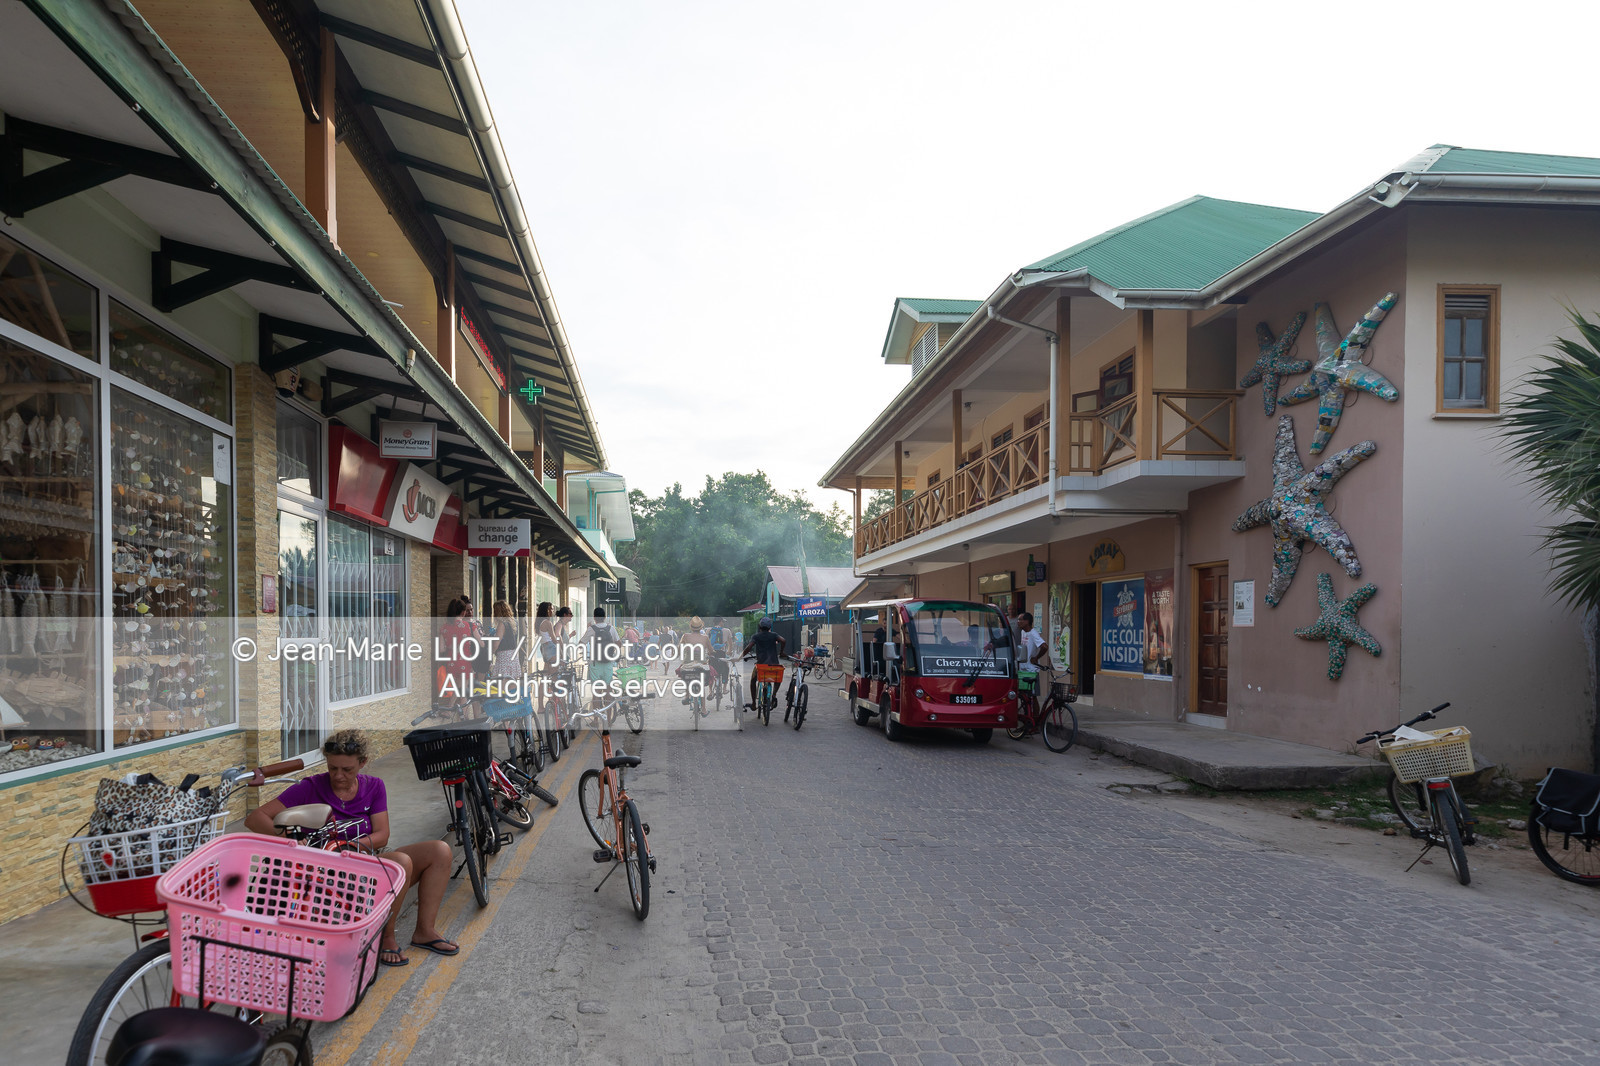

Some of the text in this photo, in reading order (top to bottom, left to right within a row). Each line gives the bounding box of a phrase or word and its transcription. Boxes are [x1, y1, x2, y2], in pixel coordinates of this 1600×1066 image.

[384, 437, 430, 445] MoneyGram
[417, 491, 436, 520] MCB
[478, 524, 518, 533] bureau de
[479, 532, 518, 545] change
[1152, 597, 1170, 605] WORTH
[1115, 602, 1135, 615] SEYBREW
[1103, 628, 1144, 646] ICE COLD
[1103, 646, 1144, 664] INSIDE
[936, 658, 995, 668] Chez Marva
